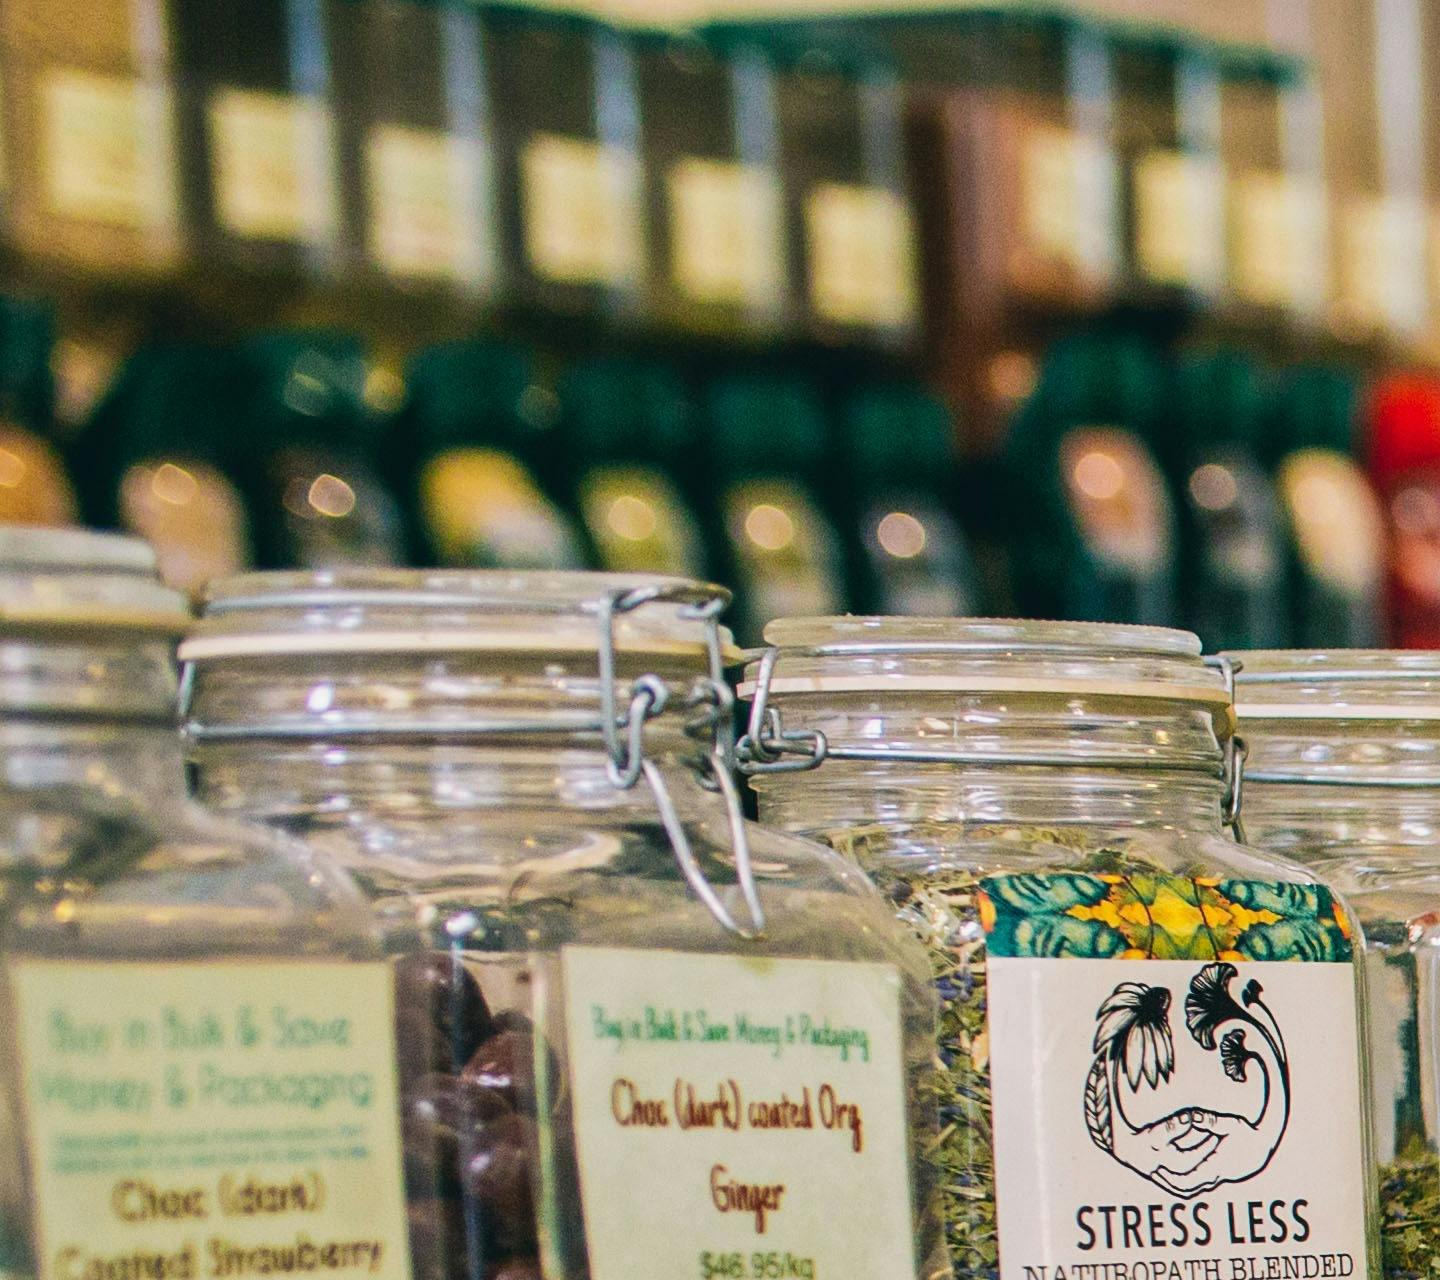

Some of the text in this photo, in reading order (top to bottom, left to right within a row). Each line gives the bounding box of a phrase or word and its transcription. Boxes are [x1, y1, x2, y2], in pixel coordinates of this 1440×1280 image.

[610, 1076, 863, 1153] Choc (dark) coated Org
[111, 1177, 208, 1224] Choc
[710, 1163, 786, 1234] Ginger
[1076, 1198, 1311, 1251] STRESS LESS
[204, 1231, 385, 1280] Strawberry
